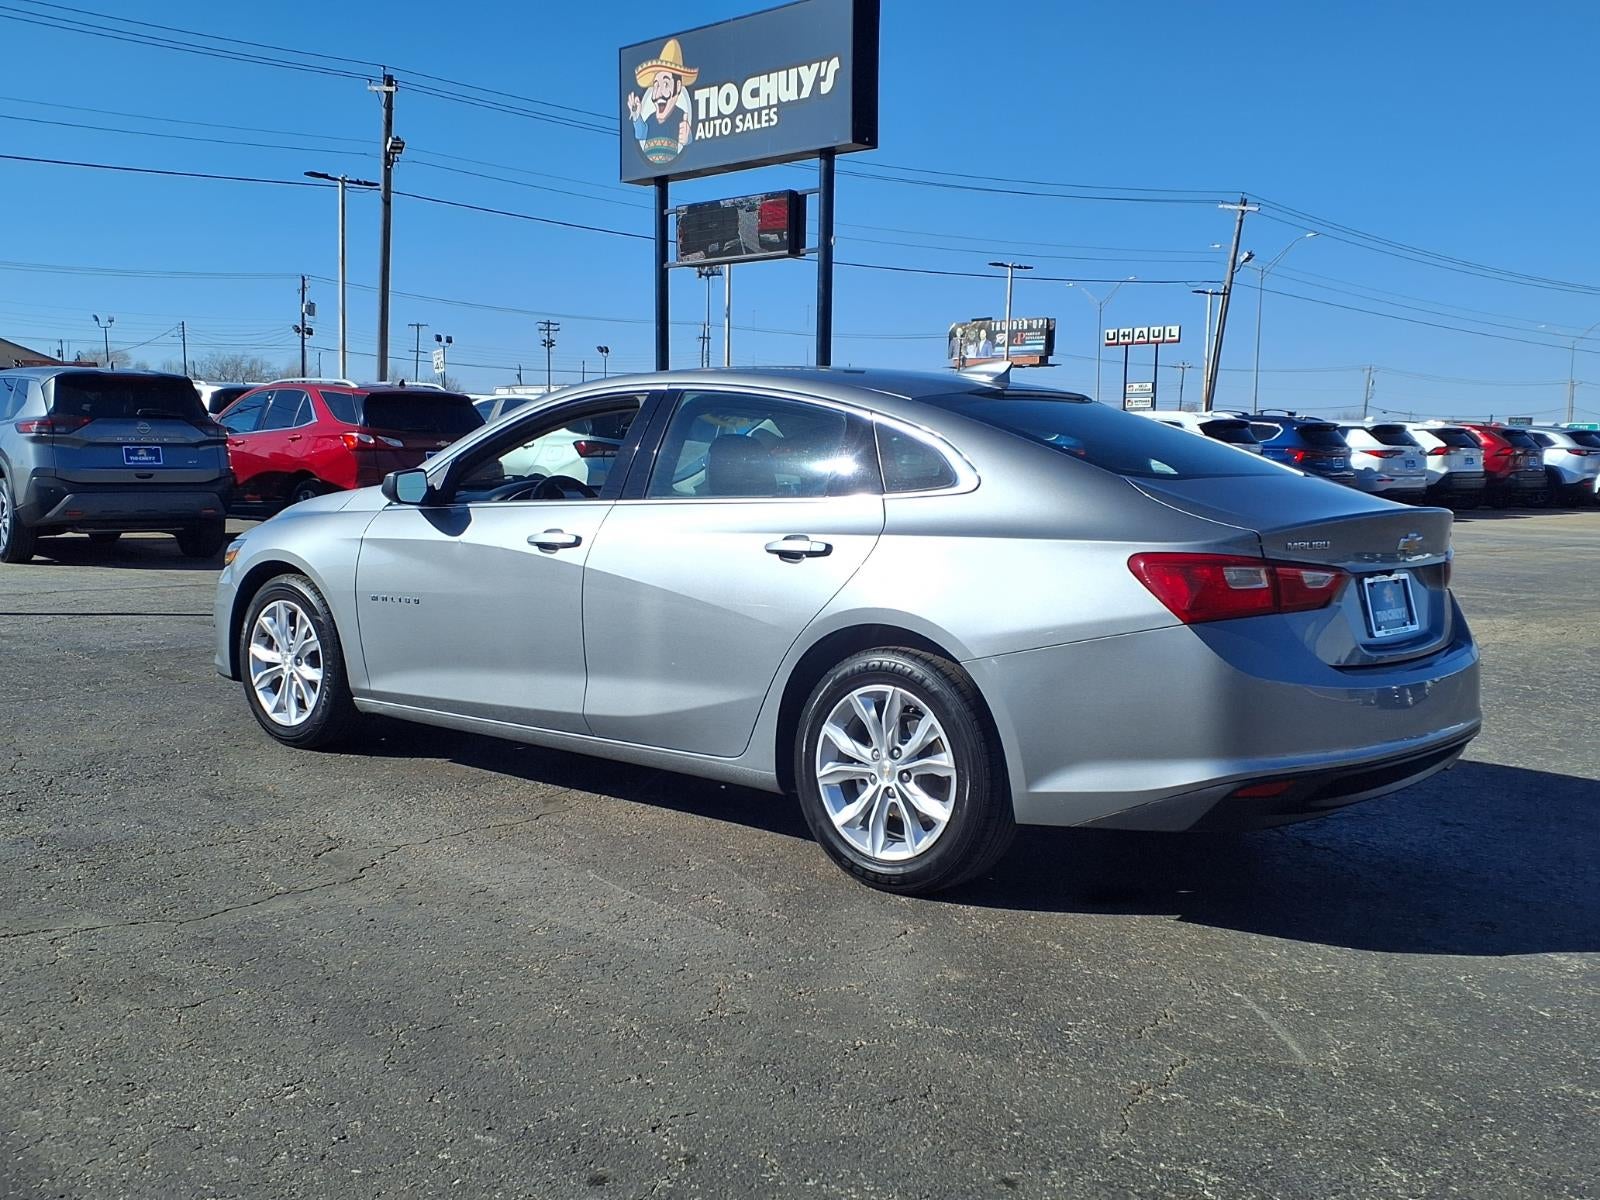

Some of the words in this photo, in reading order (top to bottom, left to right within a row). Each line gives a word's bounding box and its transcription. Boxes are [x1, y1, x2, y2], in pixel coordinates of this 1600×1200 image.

[694, 82, 738, 120] TIO
[741, 56, 840, 110] CHUY'S
[695, 117, 732, 141] AUTO
[735, 107, 778, 132] SALES
[1287, 541, 1331, 550] MALIBU
